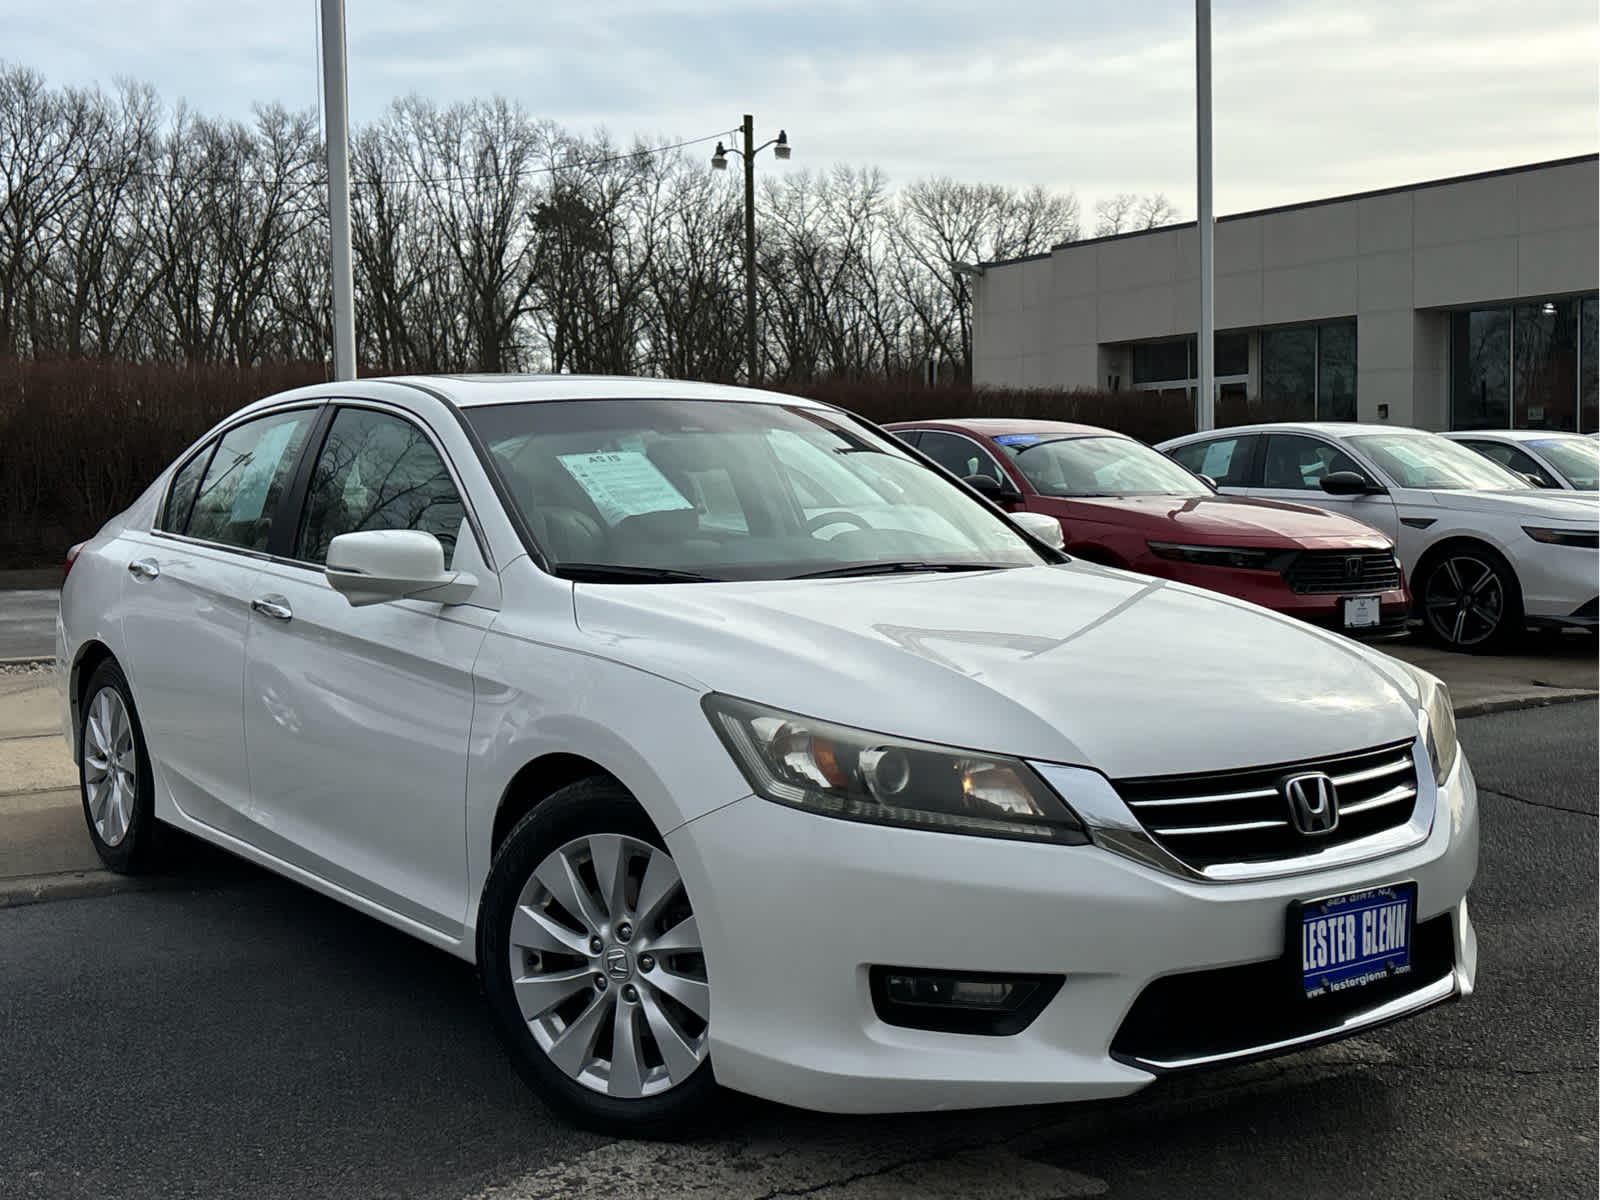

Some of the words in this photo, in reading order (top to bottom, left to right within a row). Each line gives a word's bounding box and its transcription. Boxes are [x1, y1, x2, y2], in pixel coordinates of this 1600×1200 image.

[588, 455, 606, 463] AS
[1303, 914, 1355, 971] LESTER
[1362, 903, 1407, 956] GLENN
